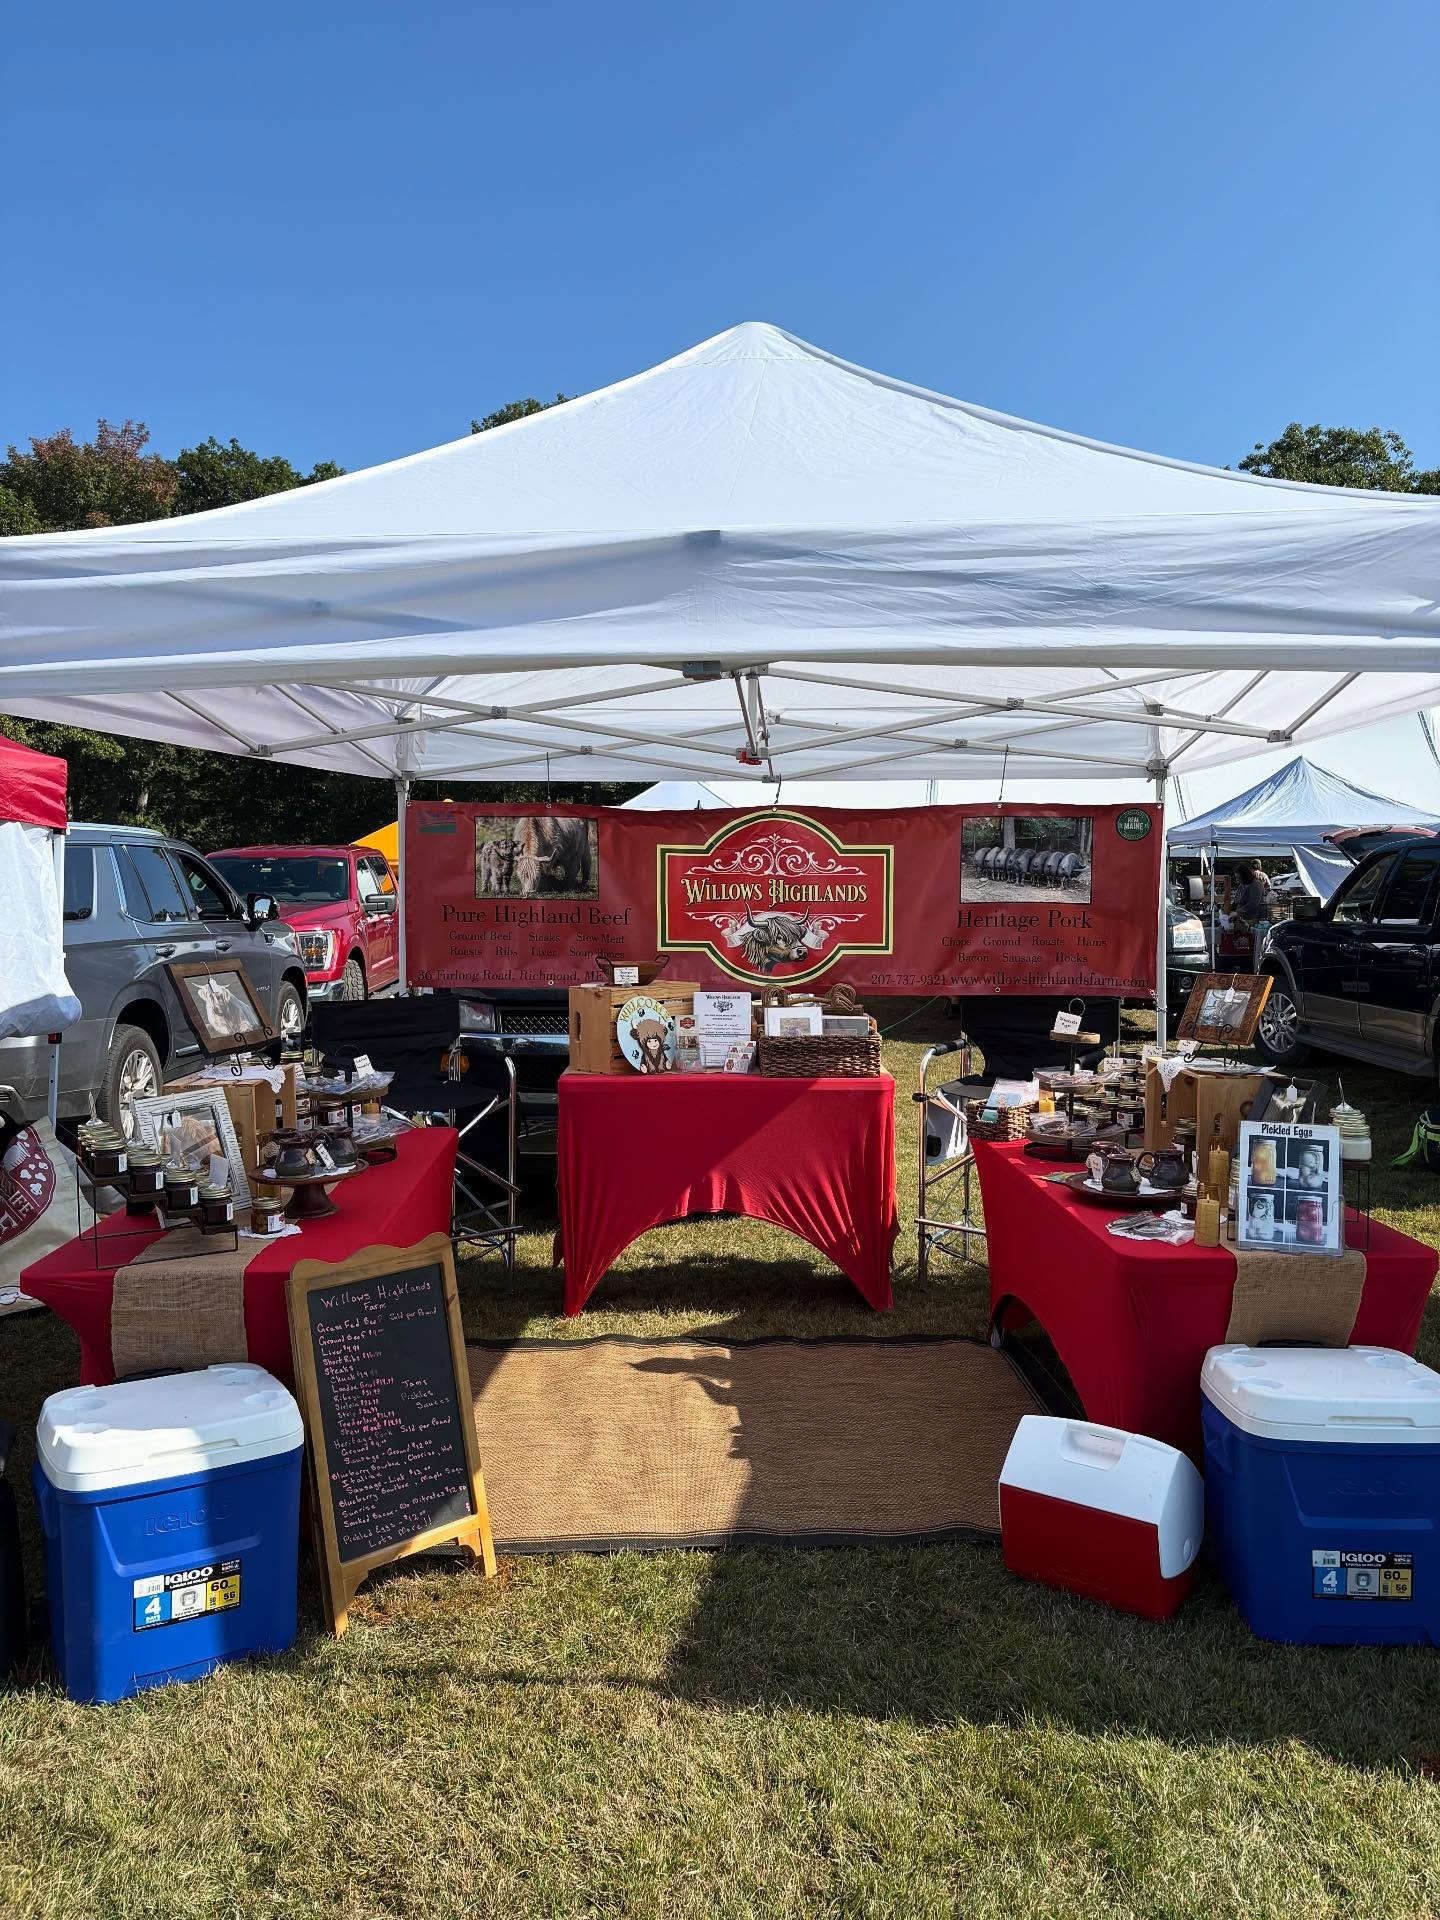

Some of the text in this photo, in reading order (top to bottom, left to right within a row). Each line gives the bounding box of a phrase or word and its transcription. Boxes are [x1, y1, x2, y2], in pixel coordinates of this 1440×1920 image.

[1123, 822, 1144, 831] MAINE
[681, 877, 868, 908] WILLOWS HIGHLANDS
[442, 904, 631, 928] Pure Highland Beef
[957, 910, 1093, 933] Heritage Pork
[449, 930, 513, 941] Ground Beef
[528, 931, 561, 943] Steaks
[576, 932, 625, 944] Stew Meat
[983, 936, 1021, 946] Ground
[1031, 935, 1065, 946] Roasts
[1077, 936, 1107, 947] Hams
[941, 937, 972, 948] Chops
[450, 945, 483, 956] Roasts
[495, 946, 518, 956] Ribs
[531, 946, 556, 957] Liver
[569, 947, 625, 959] Soup Bones
[958, 952, 989, 963] Bacon
[1002, 953, 1042, 964] Sausage
[1055, 952, 1088, 963] Hocks
[417, 970, 432, 981] 36
[436, 969, 478, 983] Furlong
[871, 973, 1149, 988] 207-737-9321 www.willowshighlandsfarm.com
[619, 997, 672, 1022] WELCOME
[1261, 1124, 1313, 1139] Pickled Eggs
[320, 1281, 431, 1308] Willows Highlands
[363, 1302, 387, 1311] Farm
[389, 1306, 437, 1321] Sold per Pound
[316, 1315, 382, 1333] Grass Fed Beef
[318, 1335, 345, 1346] Ground
[347, 1330, 366, 1341] Beef
[321, 1347, 343, 1357] Liver
[322, 1358, 343, 1366] Short
[343, 1354, 360, 1363] Ribs
[324, 1365, 354, 1375] Steaks
[330, 1373, 355, 1384] Chuck
[401, 1379, 428, 1388] Jams
[331, 1384, 358, 1393] London
[333, 1392, 360, 1402] Ribeye
[400, 1390, 434, 1401] Pickles
[334, 1402, 360, 1411] Sirloin
[415, 1397, 450, 1409] Sauces
[337, 1416, 378, 1428] Tenderloin
[400, 1416, 451, 1433] Sold per Pound
[340, 1427, 360, 1436] Stew
[362, 1423, 381, 1433] Meat
[333, 1427, 393, 1449] Heritage Pork
[341, 1446, 369, 1457] Ground
[343, 1454, 380, 1465] Sausage
[386, 1443, 410, 1456] Ground
[331, 1468, 370, 1480] Blueberry
[440, 1444, 453, 1453] Hot
[341, 1472, 382, 1488] Italian
[339, 1492, 379, 1508] Blueberry
[420, 1472, 442, 1483] Maple
[444, 1466, 463, 1476] Sage
[345, 1482, 382, 1495] Sausage
[341, 1503, 376, 1518] Sunrise
[343, 1515, 370, 1529] Smoked
[399, 1502, 410, 1510] No
[412, 1491, 445, 1504] Nitrates
[342, 1529, 373, 1545] Pickled
[375, 1522, 396, 1534] Eggs
[368, 1535, 393, 1548] Lots
[398, 1525, 422, 1537] More
[1341, 1552, 1387, 1563] IGLOO
[165, 1566, 214, 1586] IGLOO
[1322, 1570, 1338, 1588] 4
[1384, 1571, 1401, 1581] 60
[211, 1580, 229, 1592] 60
[1396, 1584, 1408, 1592] 56
[223, 1591, 236, 1600] 56
[144, 1597, 161, 1616] 4
